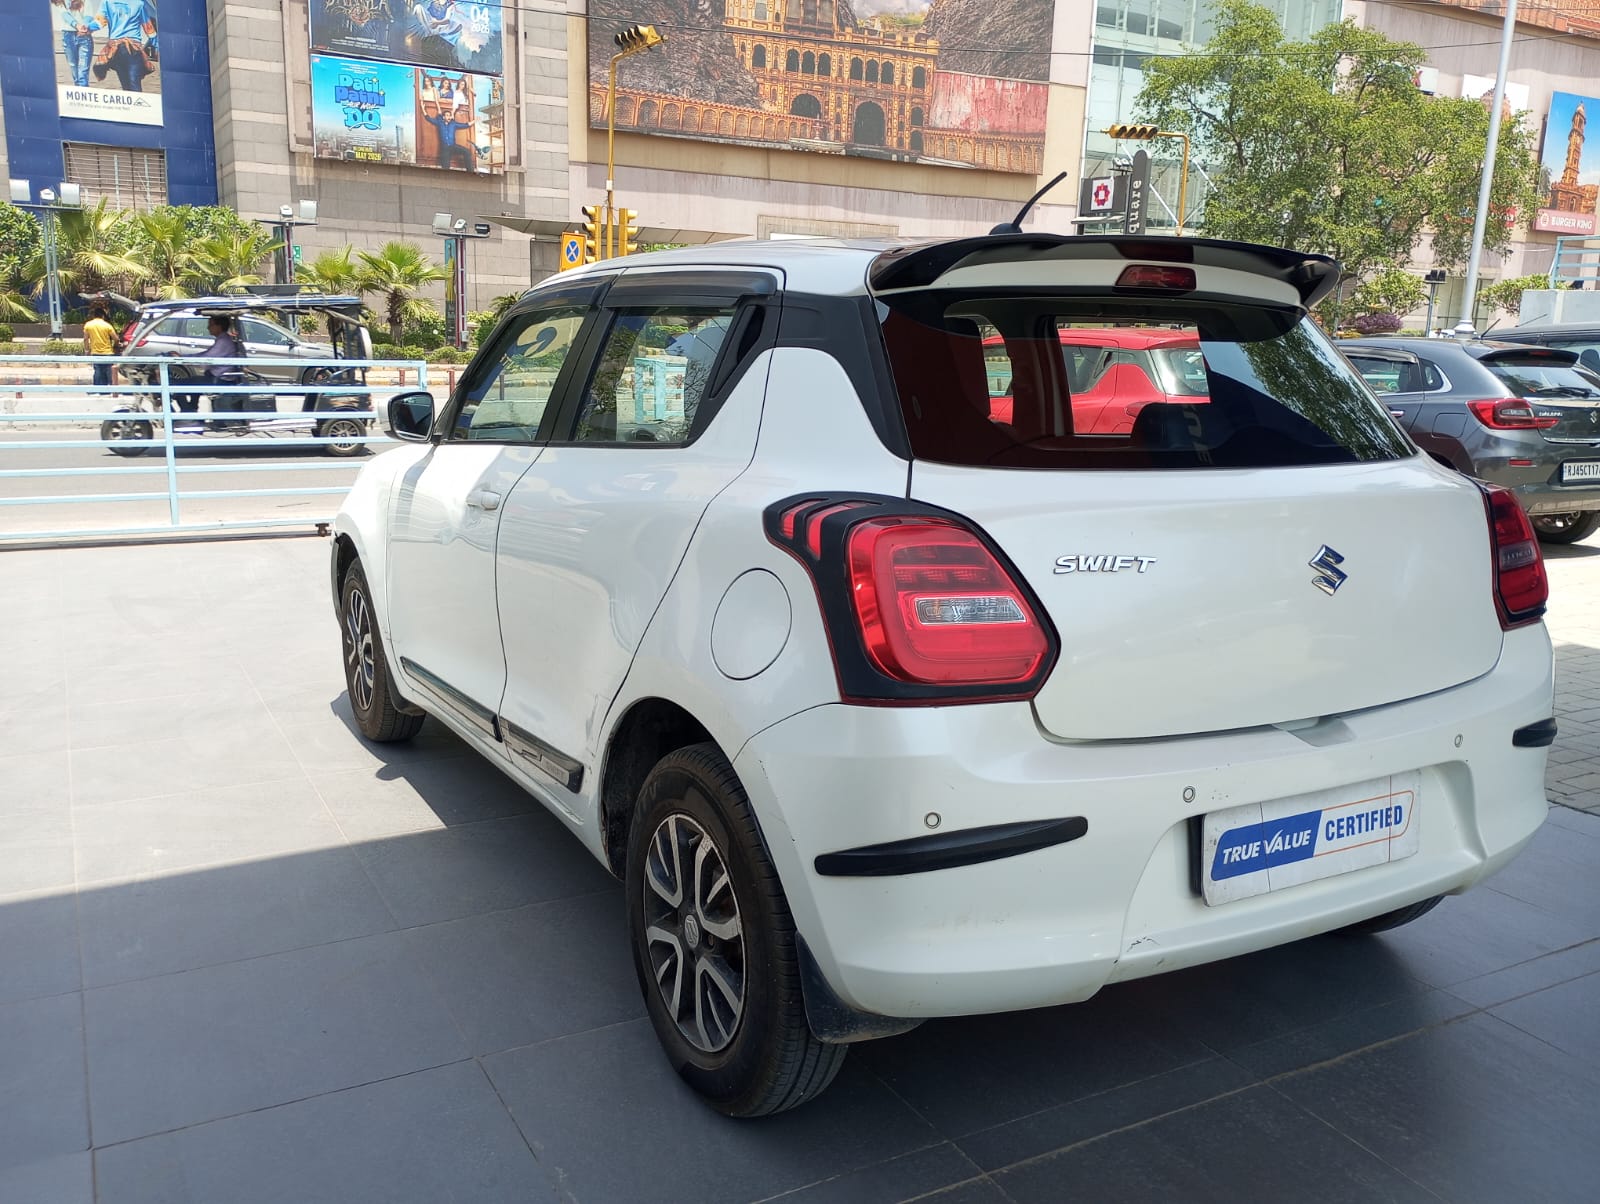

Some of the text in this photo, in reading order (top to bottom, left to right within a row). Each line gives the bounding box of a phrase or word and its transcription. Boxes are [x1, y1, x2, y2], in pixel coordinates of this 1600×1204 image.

[470, 5, 490, 24] 04
[338, 73, 380, 94] Pati
[66, 91, 99, 102] MONTE
[103, 94, 133, 106] CARLO
[335, 85, 385, 108] Patni
[1551, 216, 1593, 230] BURGER KING
[1567, 464, 1600, 476] RJ45CT17
[1053, 554, 1157, 574] SWIFT
[1223, 805, 1403, 865] TRUE VALUE CERTIFIED
